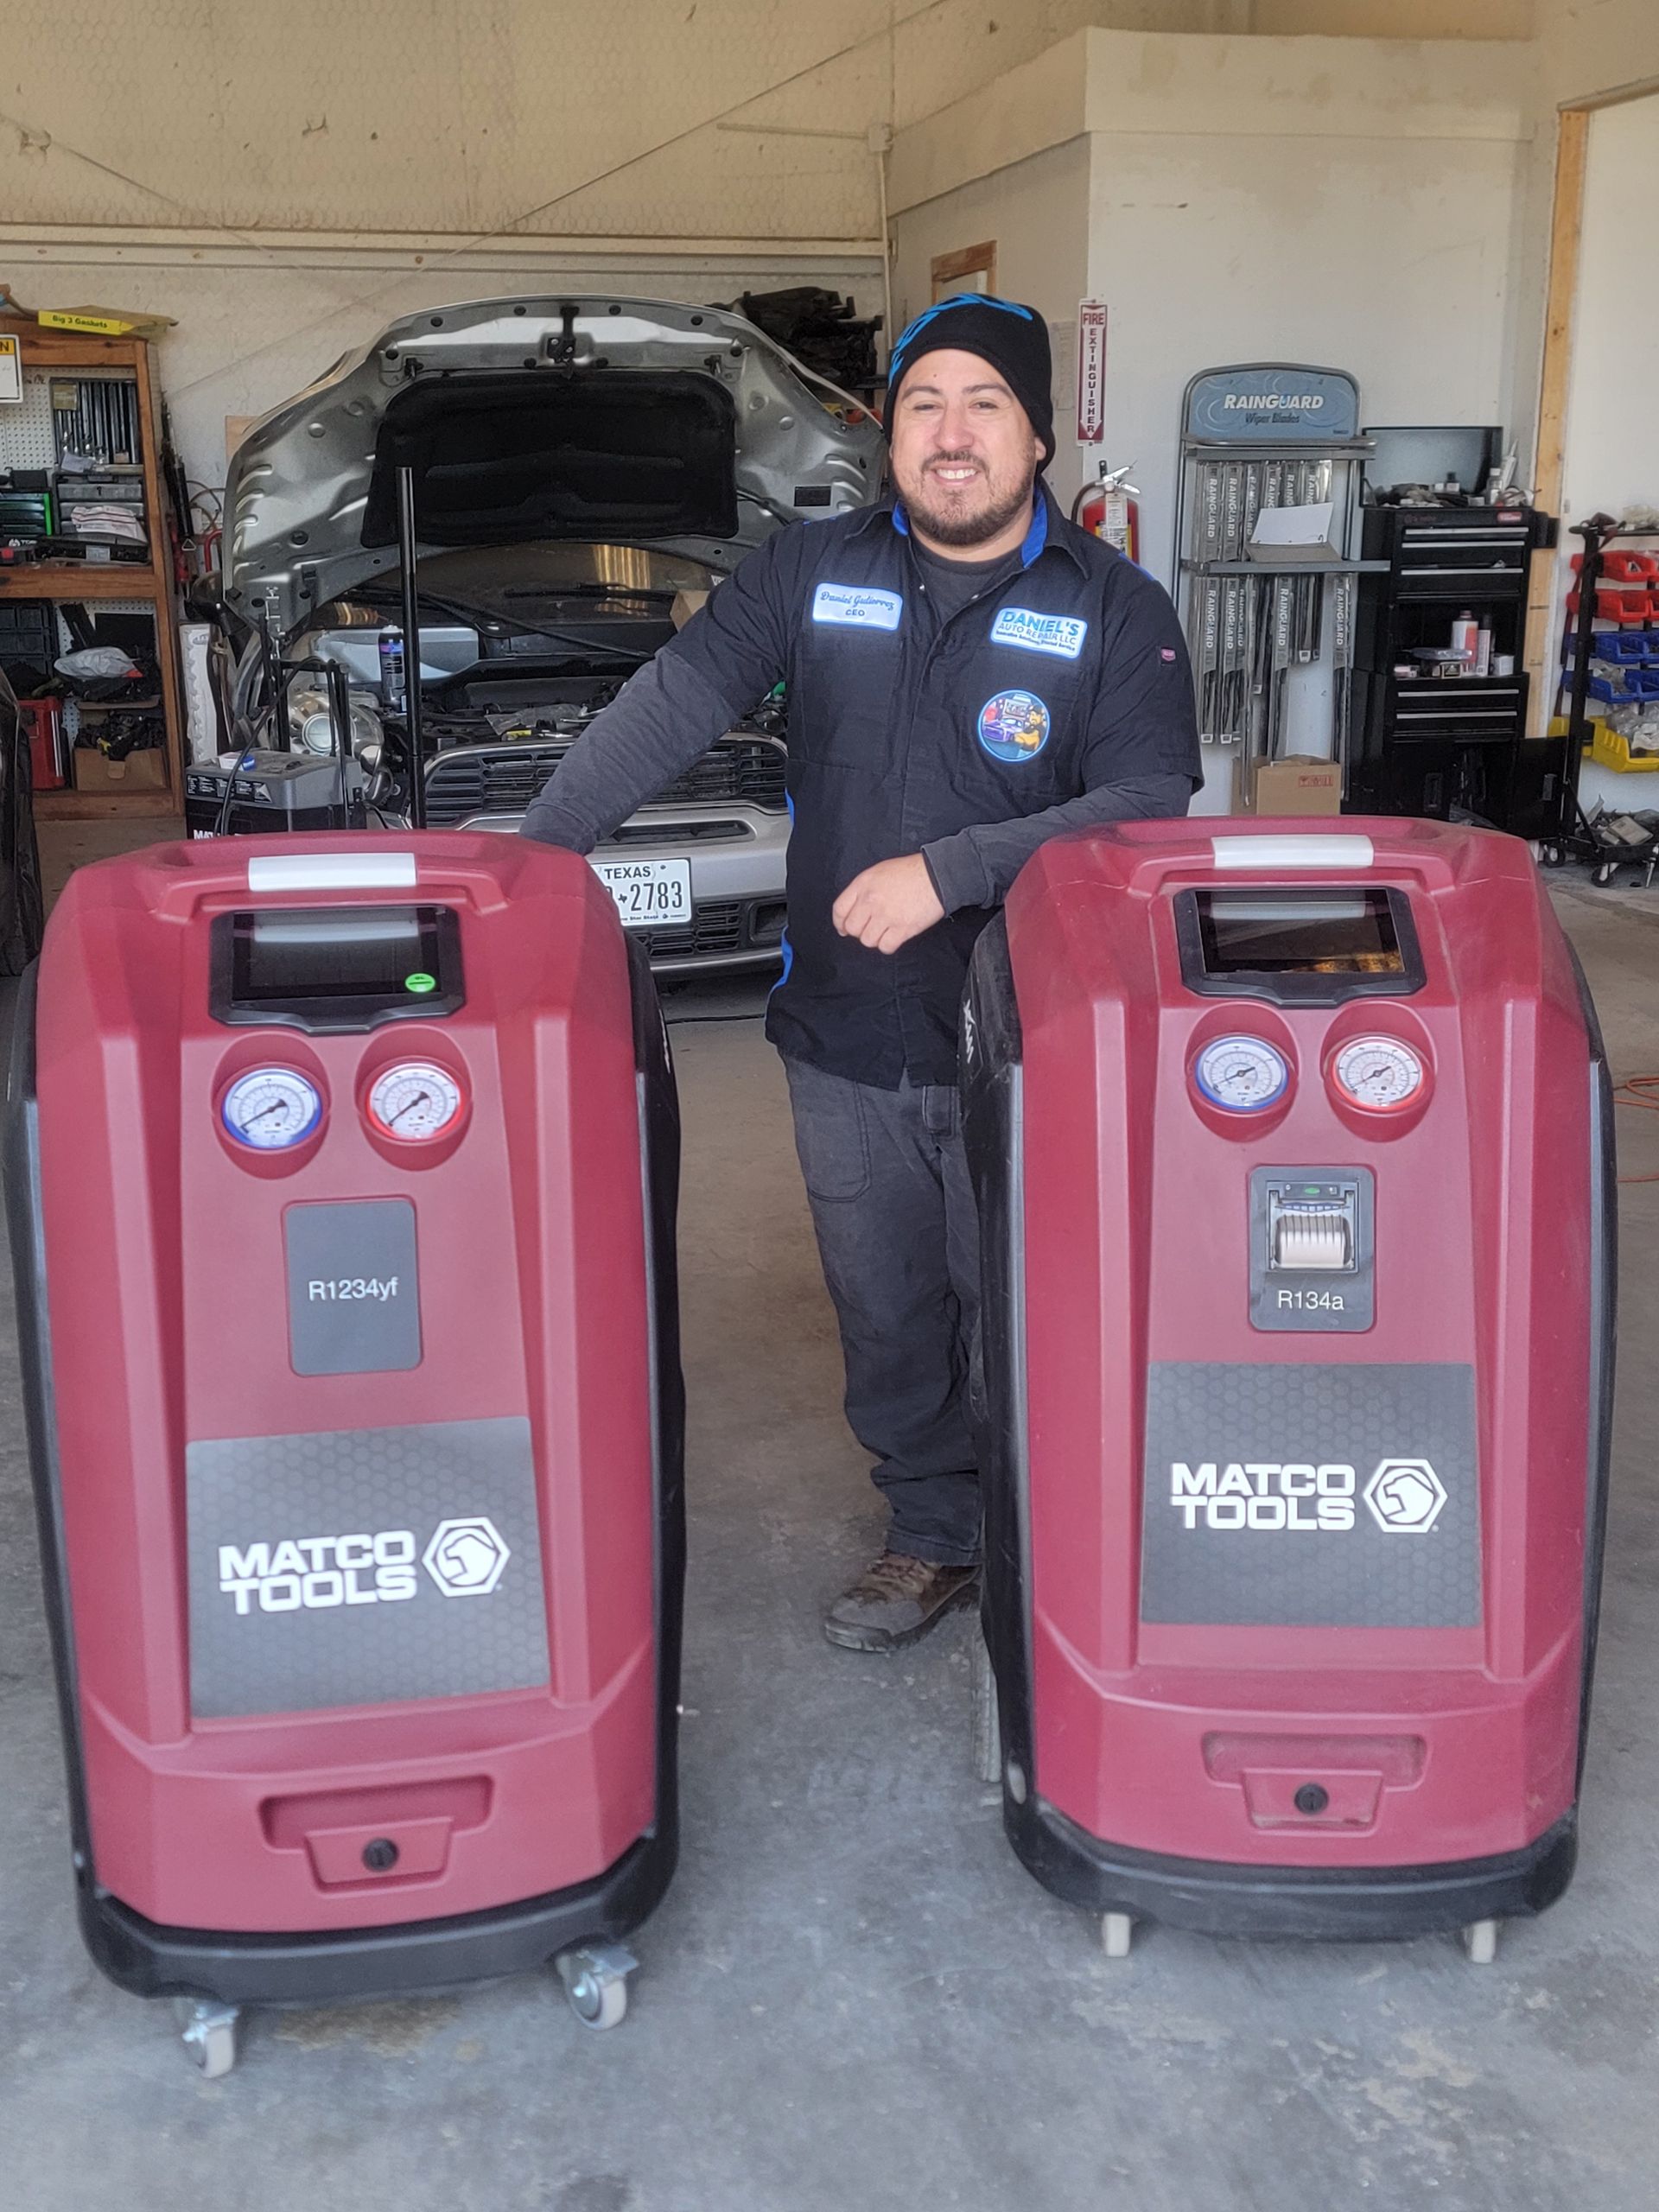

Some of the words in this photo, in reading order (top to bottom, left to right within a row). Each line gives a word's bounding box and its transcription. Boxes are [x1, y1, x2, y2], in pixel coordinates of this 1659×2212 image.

[53, 315, 66, 324] Big
[74, 318, 108, 328] Gaskets
[1083, 313, 1105, 325] FIRE
[1087, 327, 1097, 433] EXTINGUISHER
[1224, 394, 1324, 410] RAINGUARD
[1245, 413, 1271, 425] Wiper
[1272, 413, 1300, 423] Blades
[1268, 477, 1277, 508] RAING
[1286, 474, 1295, 506] RAING
[1207, 478, 1217, 537] RAINGUARD
[1227, 477, 1237, 537] RAINGUARD
[820, 591, 854, 604] Daniel
[854, 594, 895, 611] Gutierrez
[1278, 588, 1289, 646] RAINGUARD
[998, 622, 1025, 633] AUTO
[1026, 628, 1058, 641] REPAIR
[1059, 634, 1077, 645] LLC
[1001, 611, 1080, 637] DANIEL'S
[1206, 589, 1217, 648] RAINGUARD
[1227, 590, 1236, 650] RAINGUARD
[605, 866, 651, 880] TEXAS
[630, 880, 683, 912] 2783
[308, 1276, 399, 1301] R1234yf
[1277, 1290, 1344, 1311] R134a
[1171, 1462, 1356, 1497] MATCO
[1170, 1496, 1356, 1530] TOOLS
[218, 1529, 416, 1581] MATCO
[219, 1565, 417, 1616] TOOLS
